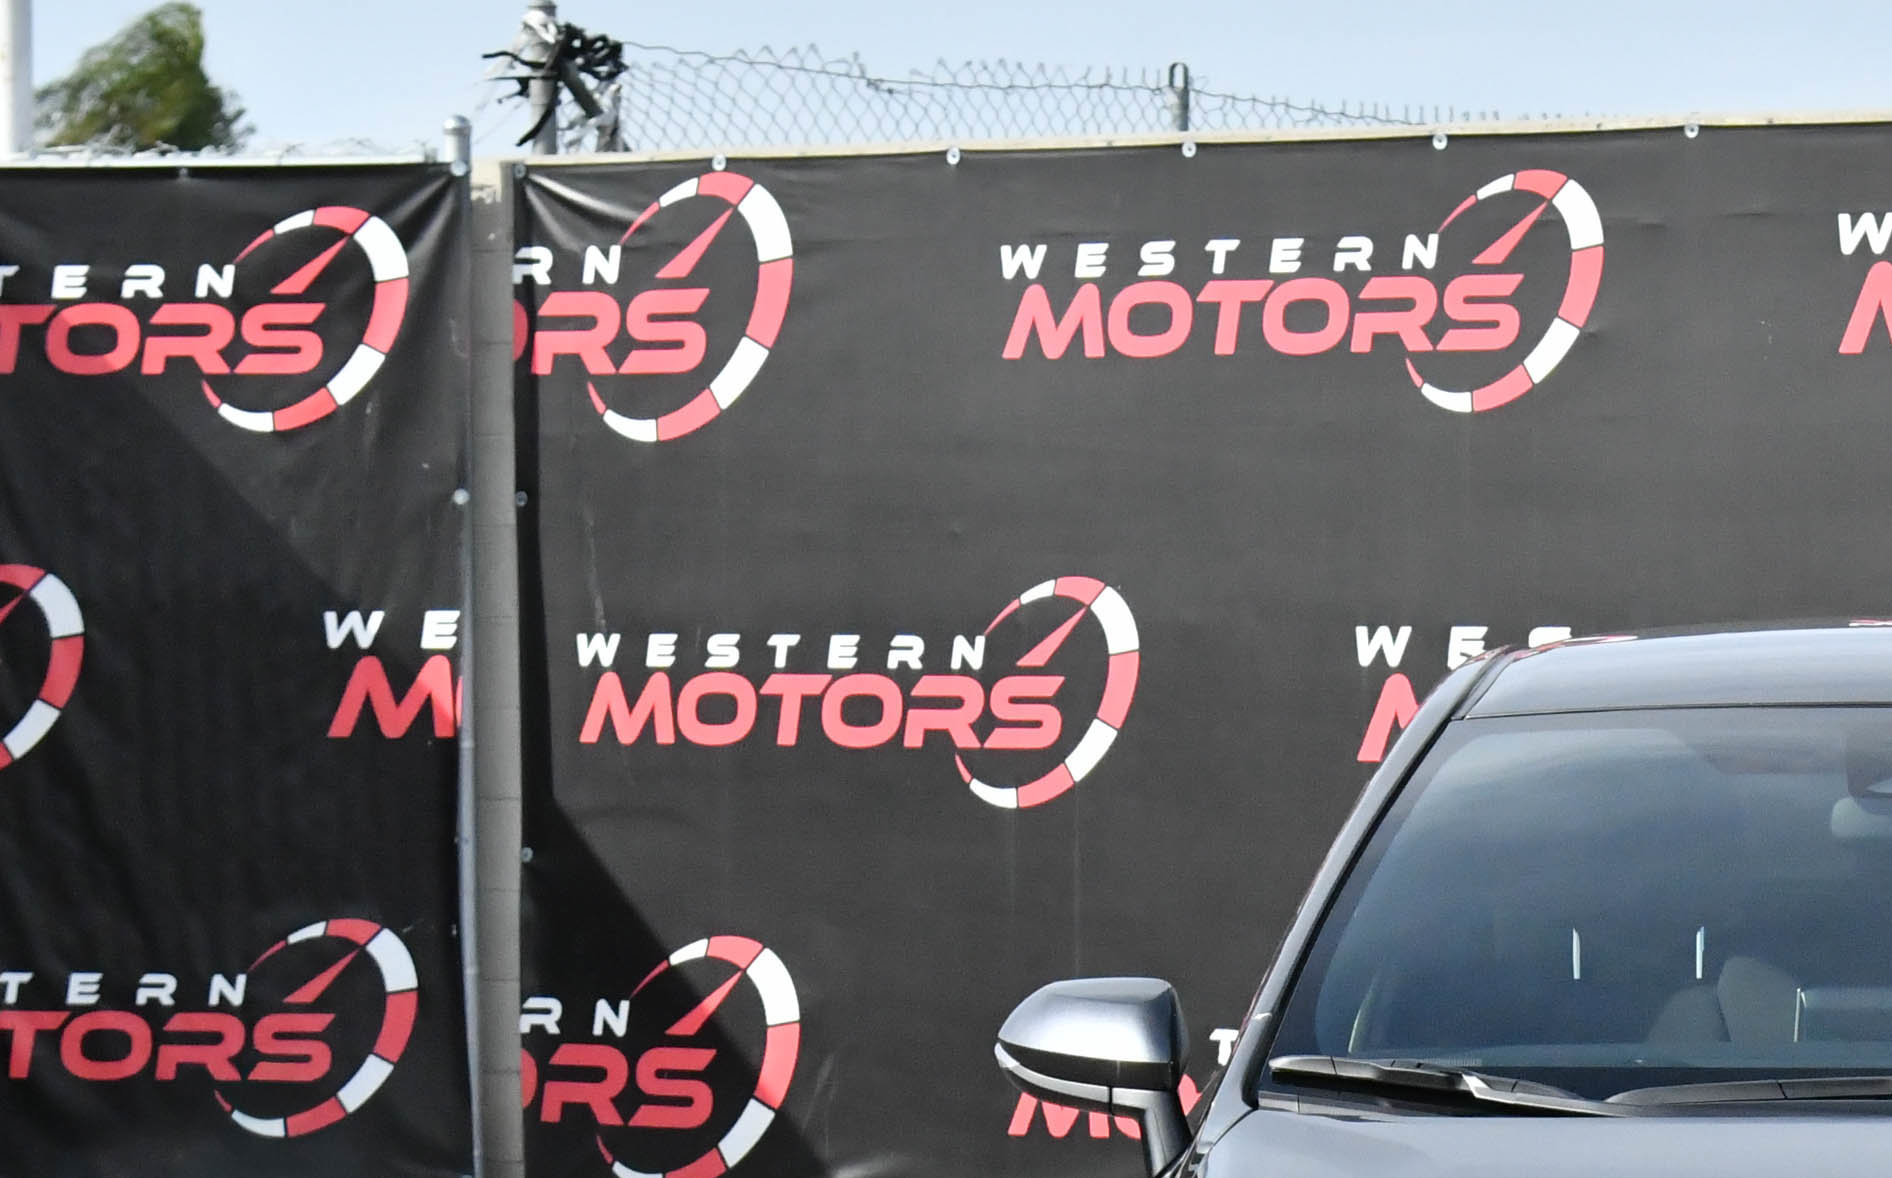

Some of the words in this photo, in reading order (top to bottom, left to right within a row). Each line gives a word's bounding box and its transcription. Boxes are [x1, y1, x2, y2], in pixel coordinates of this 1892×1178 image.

[1000, 234, 1439, 280] WESTERN
[514, 288, 710, 376] RS
[1003, 274, 1523, 360] MOTORS
[577, 633, 985, 670] WESTERN
[580, 671, 1064, 750] MOTORS
[521, 1044, 716, 1128] RS
